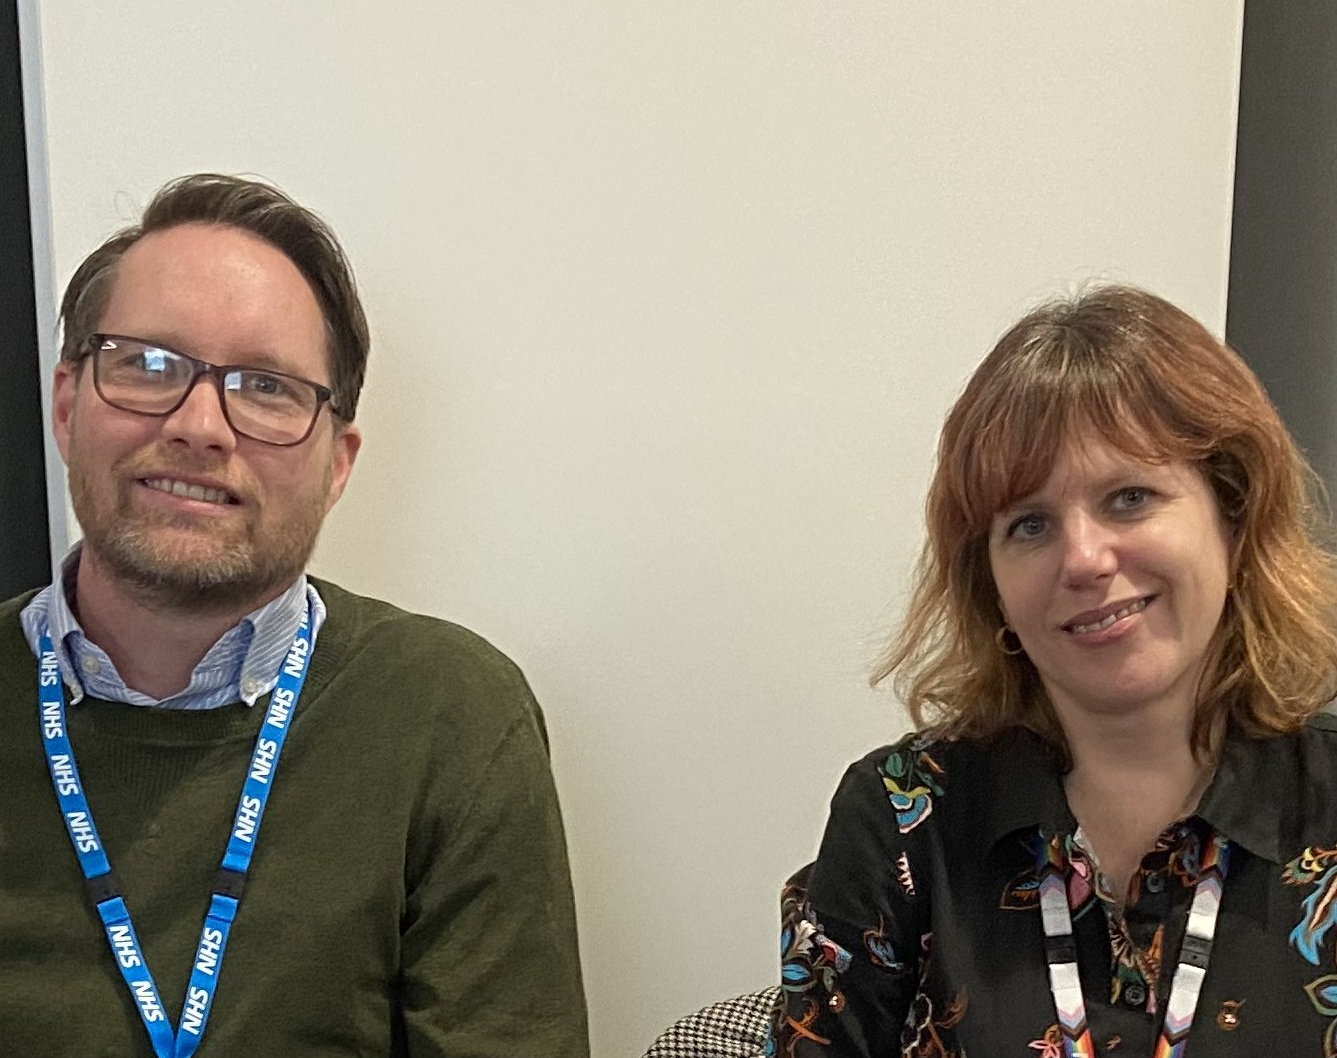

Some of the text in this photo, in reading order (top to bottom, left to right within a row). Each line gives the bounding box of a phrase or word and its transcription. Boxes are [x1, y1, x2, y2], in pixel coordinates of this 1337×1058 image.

[284, 638, 309, 679] NHS
[42, 701, 63, 740] NHS
[267, 687, 295, 729] NHS
[51, 755, 79, 797] NHS
[250, 738, 277, 784] NHS
[67, 812, 99, 853] NHS
[234, 794, 261, 843] NHS
[109, 925, 140, 969] NHS
[196, 927, 223, 976] NHS
[132, 981, 164, 1023] NHS
[182, 987, 209, 1036] NHS
